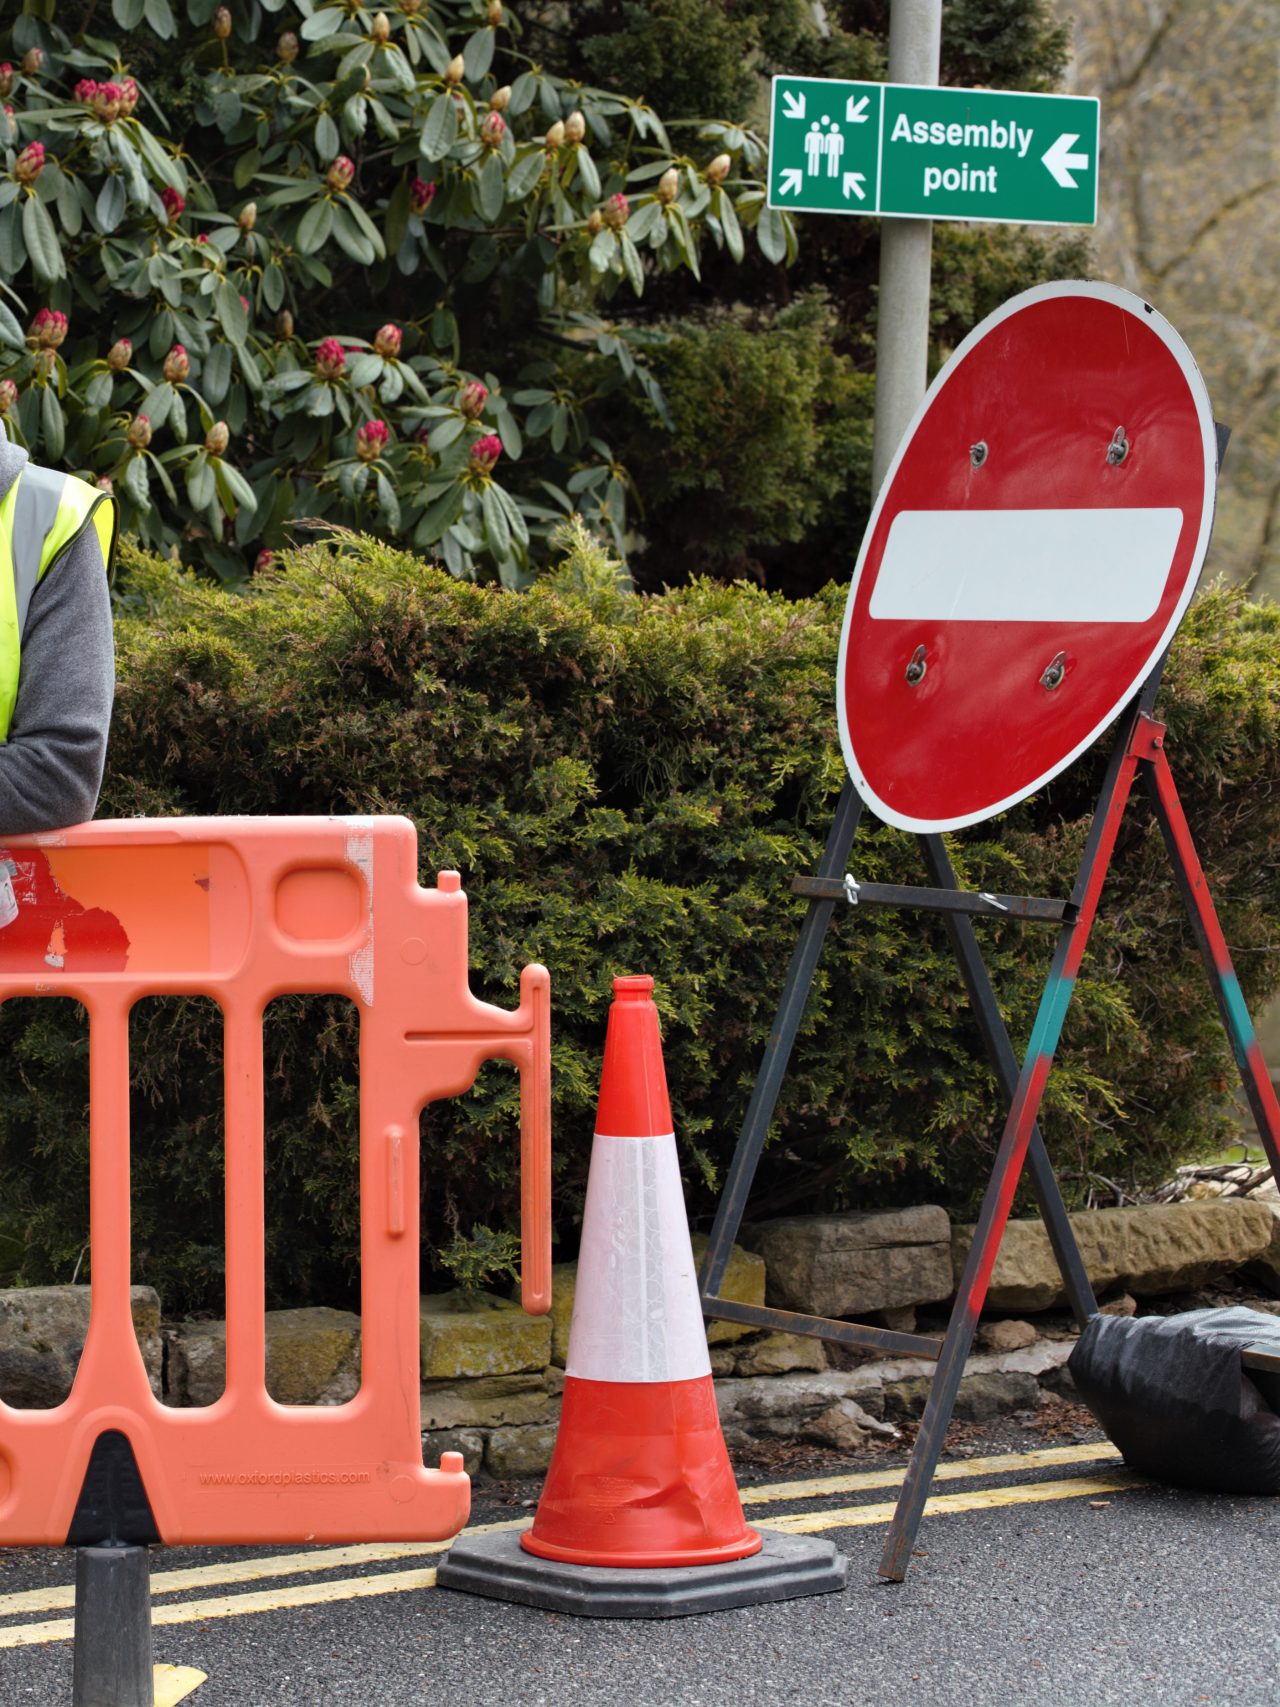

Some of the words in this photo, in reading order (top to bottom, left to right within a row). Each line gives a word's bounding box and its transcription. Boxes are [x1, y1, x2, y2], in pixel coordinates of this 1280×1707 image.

[890, 114, 1033, 158] Assembly
[923, 162, 998, 197] point
[199, 1470, 370, 1487] www.oxfordplastics.com
